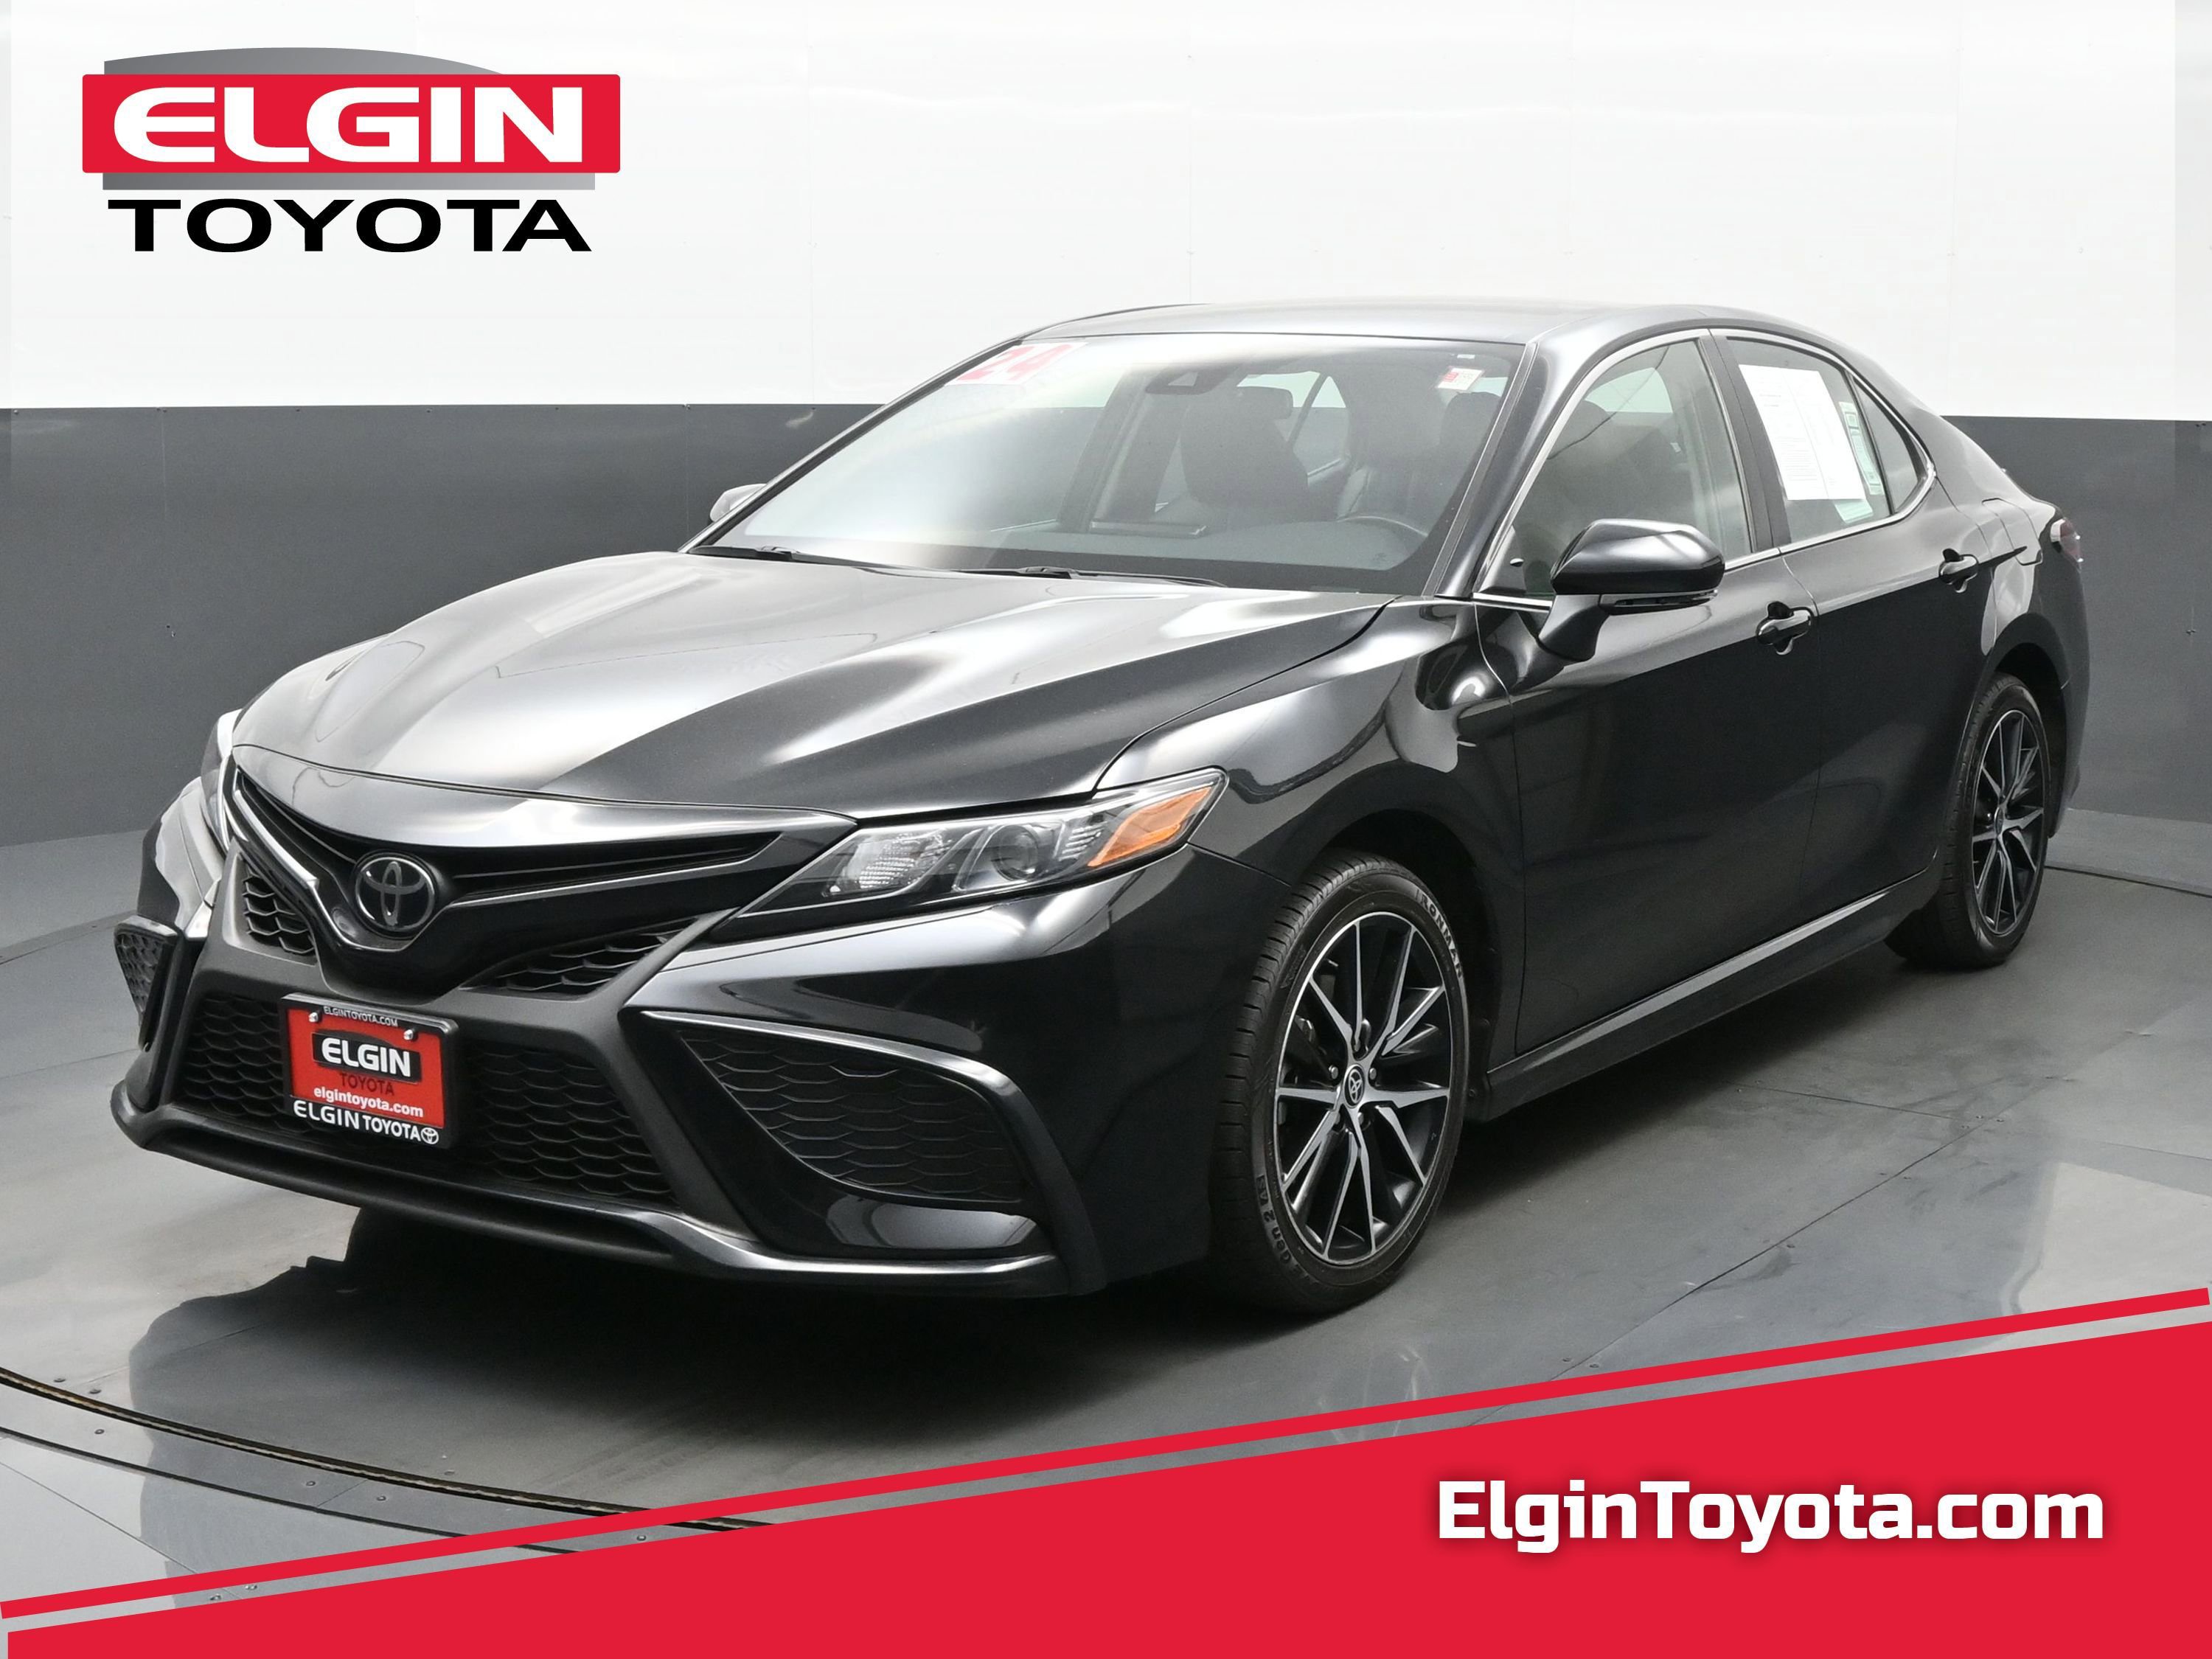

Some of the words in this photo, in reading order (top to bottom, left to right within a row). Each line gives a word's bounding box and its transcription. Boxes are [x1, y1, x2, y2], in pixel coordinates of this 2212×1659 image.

[956, 344, 1075, 381] 24
[1414, 888, 1464, 979] IRONMAN
[324, 1006, 399, 1027] ELGINTOYOTA.COM
[321, 1037, 411, 1077] ELGIN
[340, 1073, 394, 1096] TOYOTA
[313, 1086, 424, 1118] elgintoyota.com
[293, 1099, 360, 1130] ELGIN
[362, 1114, 421, 1141] TOYOTA
[1263, 1209, 1276, 1222] 2
